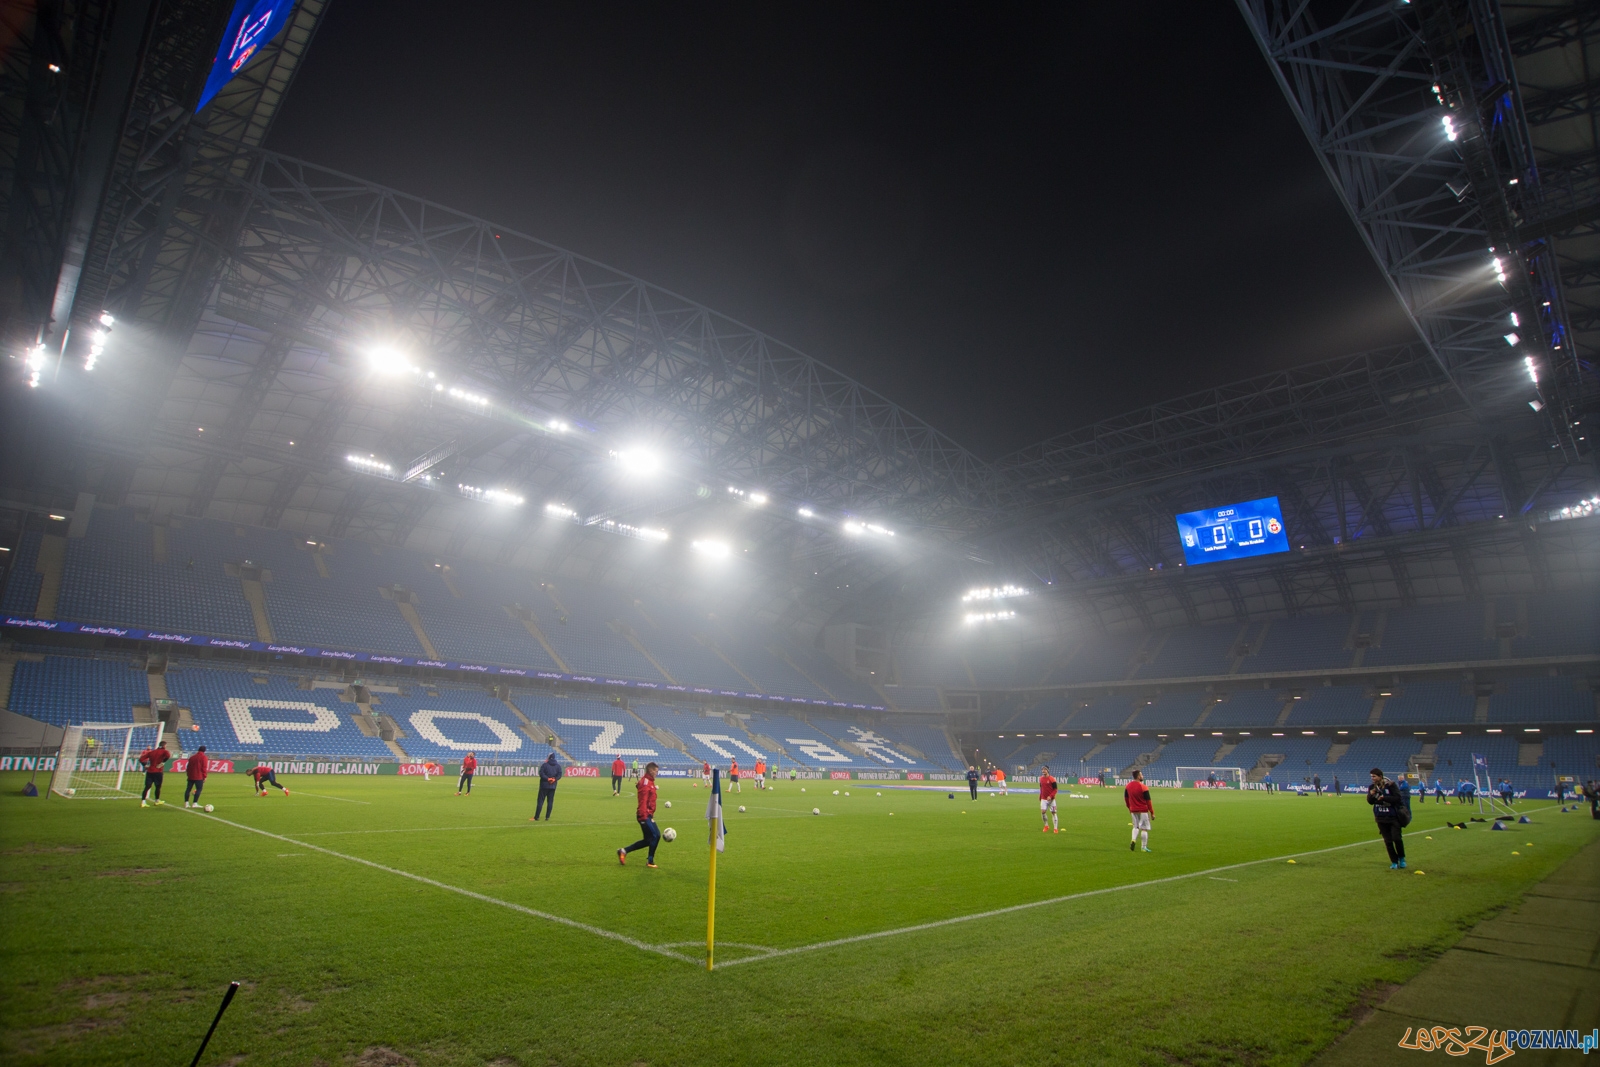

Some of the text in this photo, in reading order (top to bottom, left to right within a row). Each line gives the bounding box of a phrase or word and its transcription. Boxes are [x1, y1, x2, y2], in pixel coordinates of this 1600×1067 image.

[1213, 519, 1263, 544] 0 0
[60, 756, 144, 772] OFICJALN
[177, 760, 229, 773] ŁŻA
[316, 762, 380, 775] OFICJALNY
[402, 764, 440, 776] ŁOMA
[460, 765, 502, 777] PRTNER
